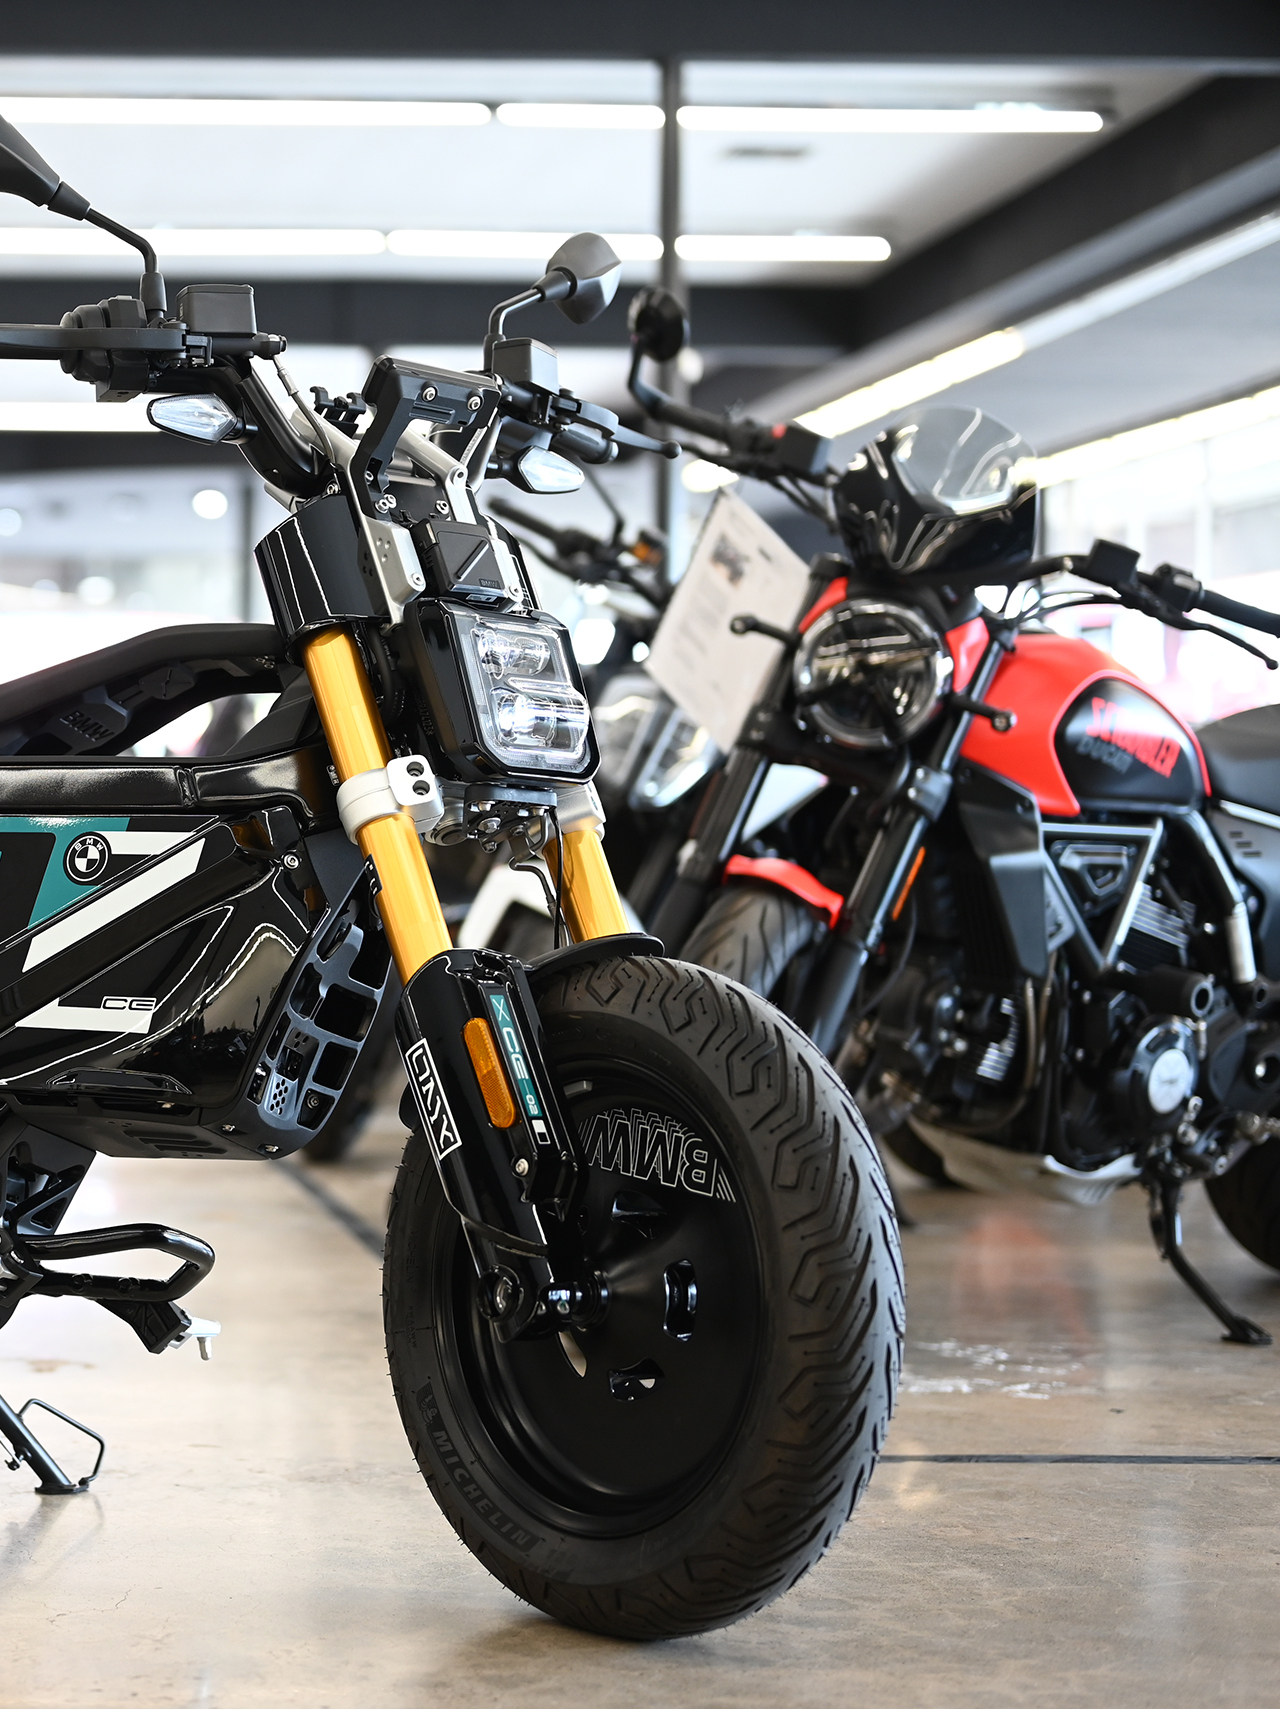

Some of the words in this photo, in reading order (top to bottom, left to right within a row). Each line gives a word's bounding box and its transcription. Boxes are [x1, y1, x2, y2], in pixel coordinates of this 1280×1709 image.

[61, 711, 115, 742] BMW
[74, 838, 104, 851] BMW
[101, 997, 156, 1011] CE
[583, 1112, 718, 1197] BMW
[432, 1429, 530, 1546] MICHELIN
